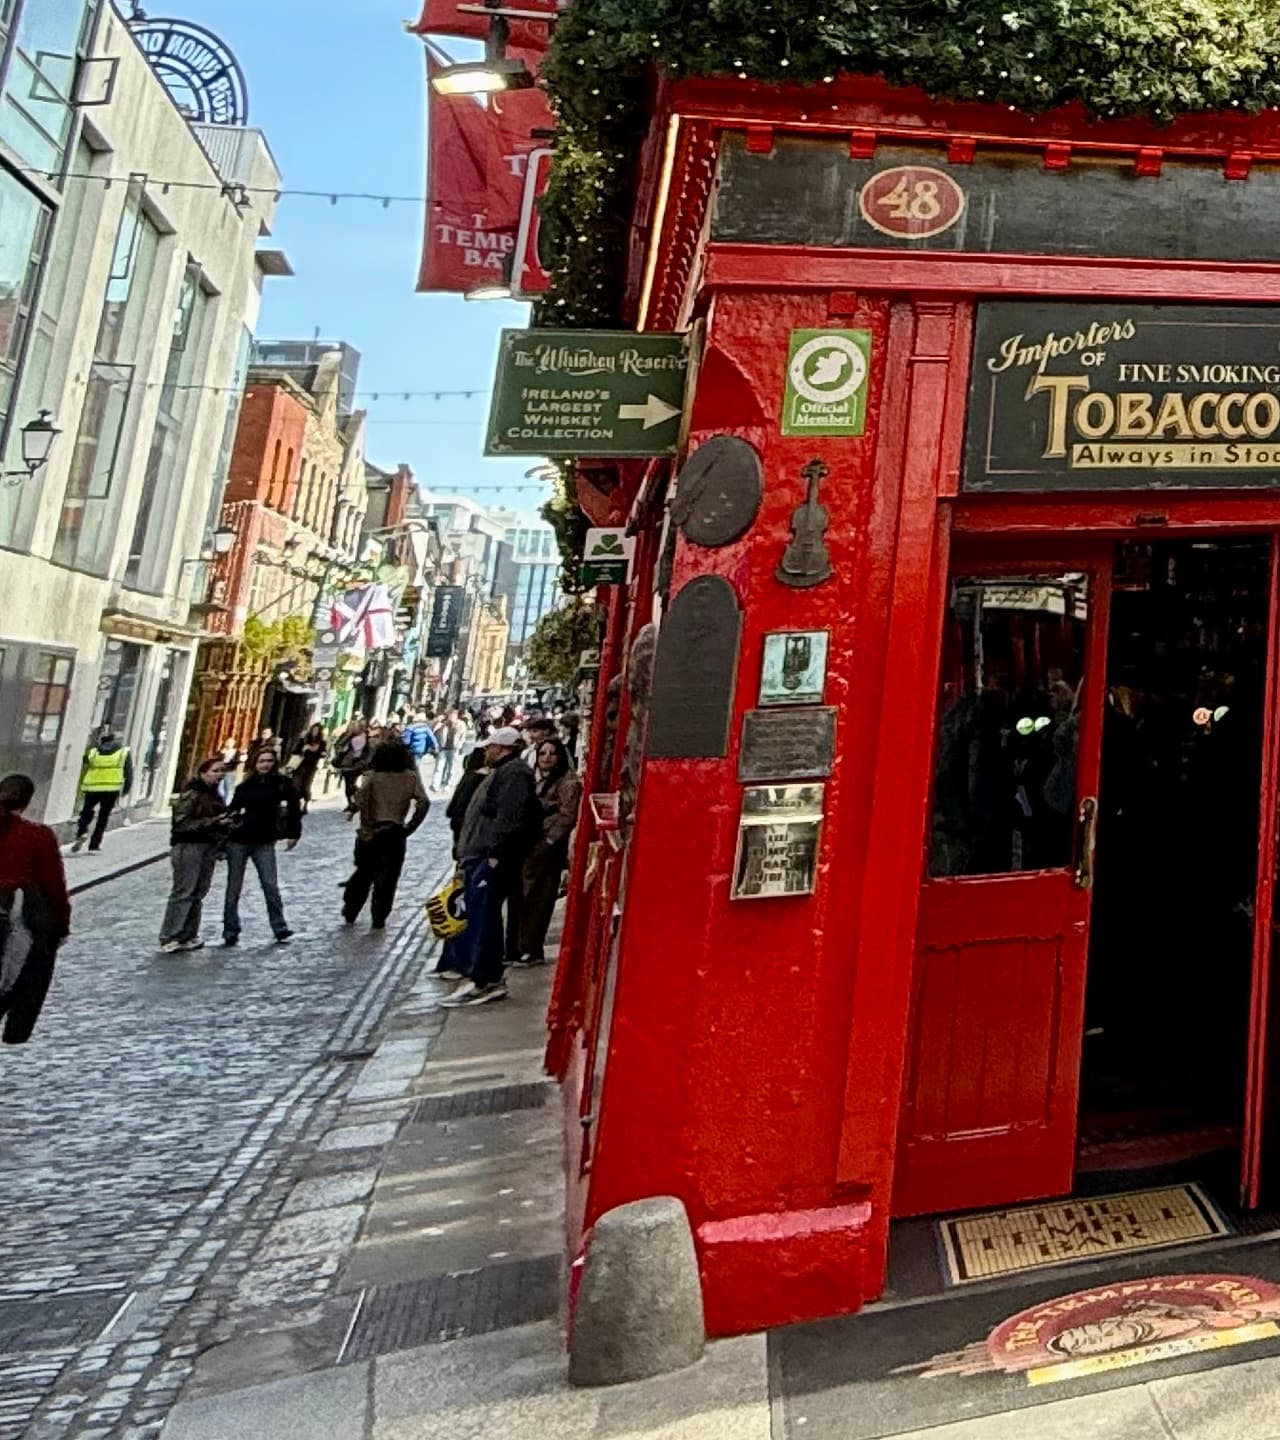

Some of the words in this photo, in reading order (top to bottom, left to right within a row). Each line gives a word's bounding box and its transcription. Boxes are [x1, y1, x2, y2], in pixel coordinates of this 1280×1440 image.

[877, 174, 943, 221] 48
[987, 317, 1137, 373] Importers
[514, 349, 534, 368] The
[534, 344, 617, 376] Whiskey
[619, 349, 687, 377] Reserve
[1081, 351, 1107, 367] OF
[1118, 363, 1170, 383] FINE
[521, 388, 611, 401] IRELAND'S
[526, 401, 603, 413] LARGEST
[523, 414, 603, 426] WHISKEY
[507, 427, 614, 439] COLLECTION
[1075, 444, 1174, 466] Always
[1190, 446, 1214, 464] in
